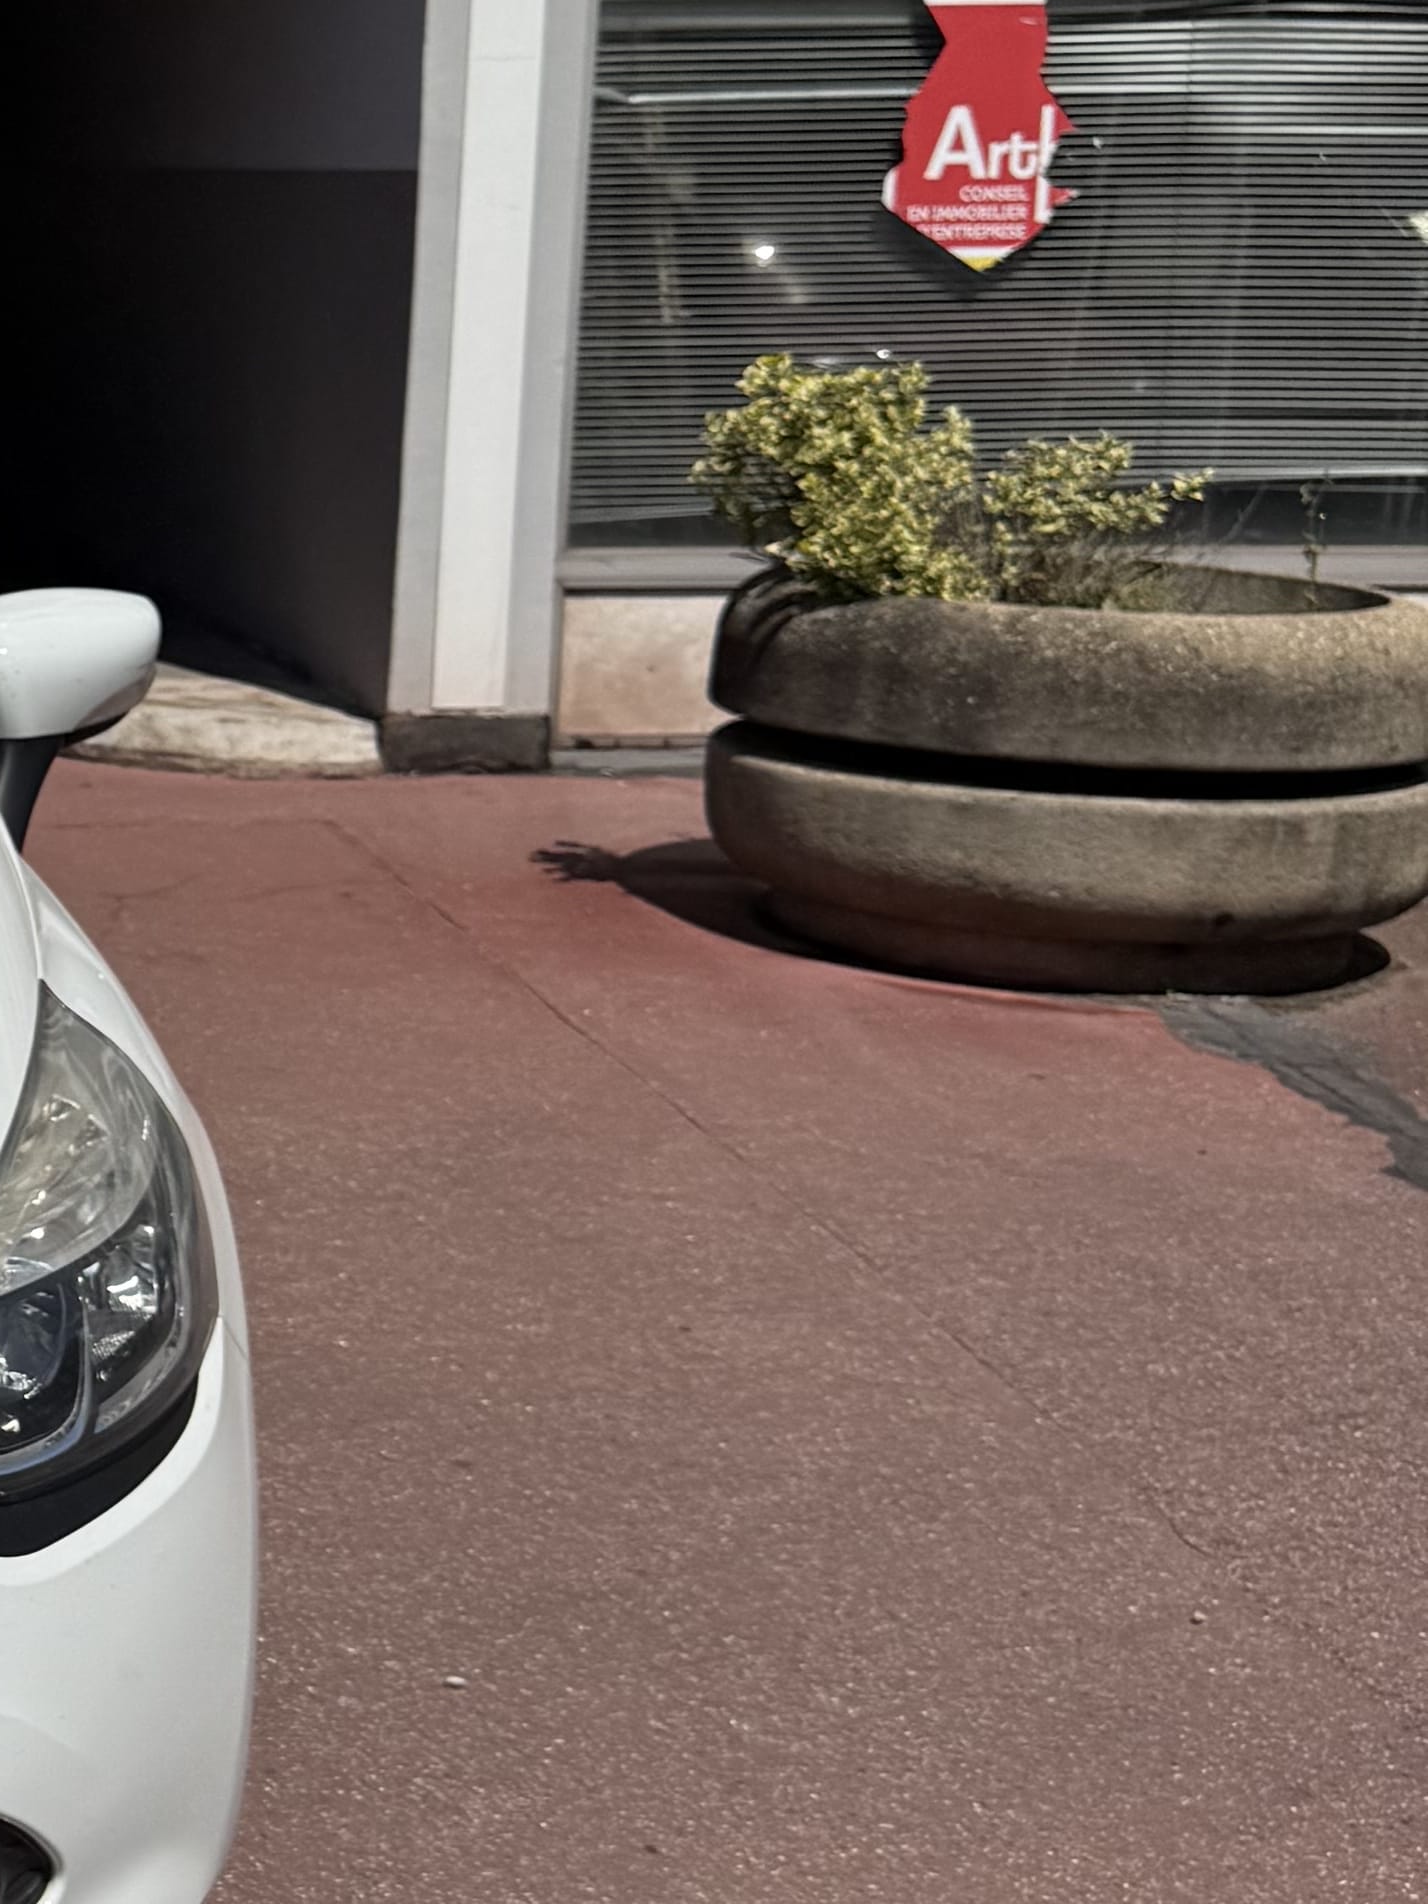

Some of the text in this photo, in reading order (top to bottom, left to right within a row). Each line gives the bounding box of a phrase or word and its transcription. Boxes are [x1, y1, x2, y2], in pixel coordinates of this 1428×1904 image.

[958, 184, 1030, 203] CONSEIL
[906, 203, 1029, 223] EN IMMOBILIER
